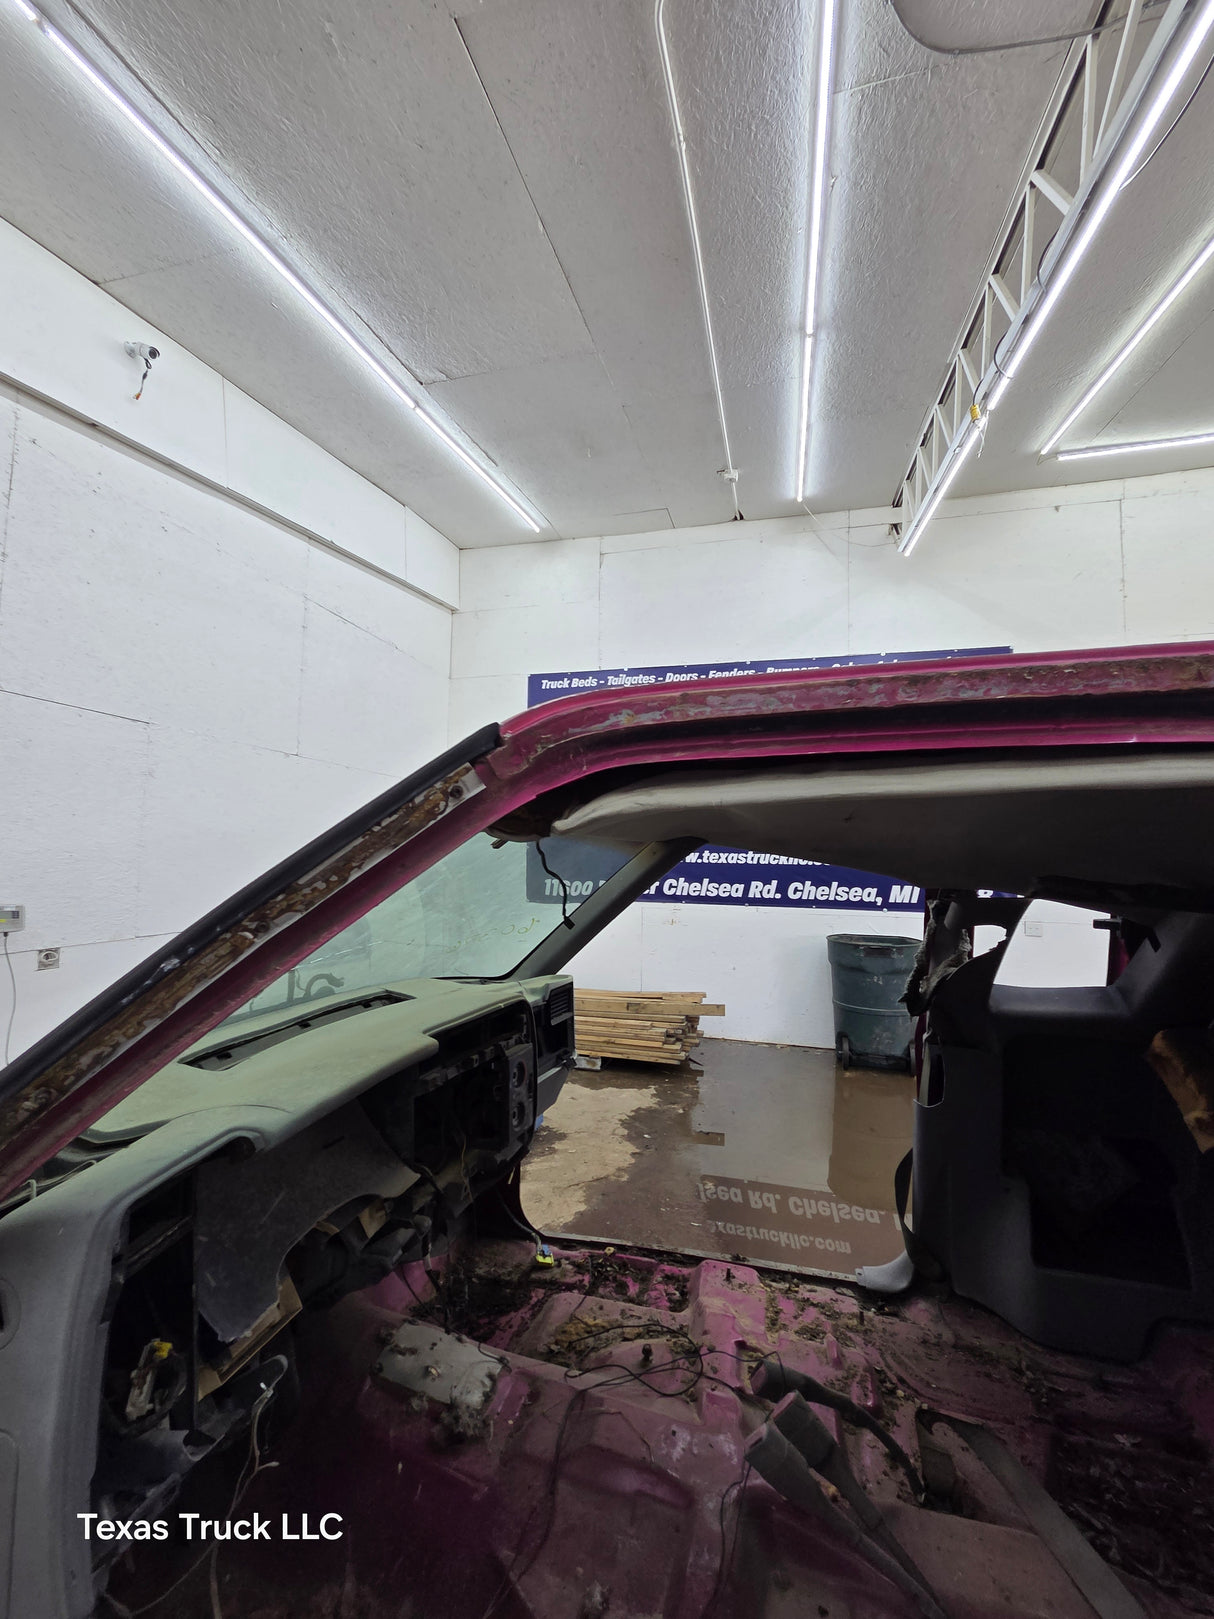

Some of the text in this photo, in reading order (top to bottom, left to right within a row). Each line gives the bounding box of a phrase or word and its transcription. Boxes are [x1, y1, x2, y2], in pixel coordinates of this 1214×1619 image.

[541, 678, 570, 689] Truck
[571, 677, 597, 688] Beds
[607, 674, 656, 687] Tailgates
[665, 673, 699, 683] Doors
[662, 877, 745, 897] Chelsea
[748, 880, 782, 899] Rd.
[787, 881, 883, 906] Chelsea,
[888, 885, 920, 904] MI
